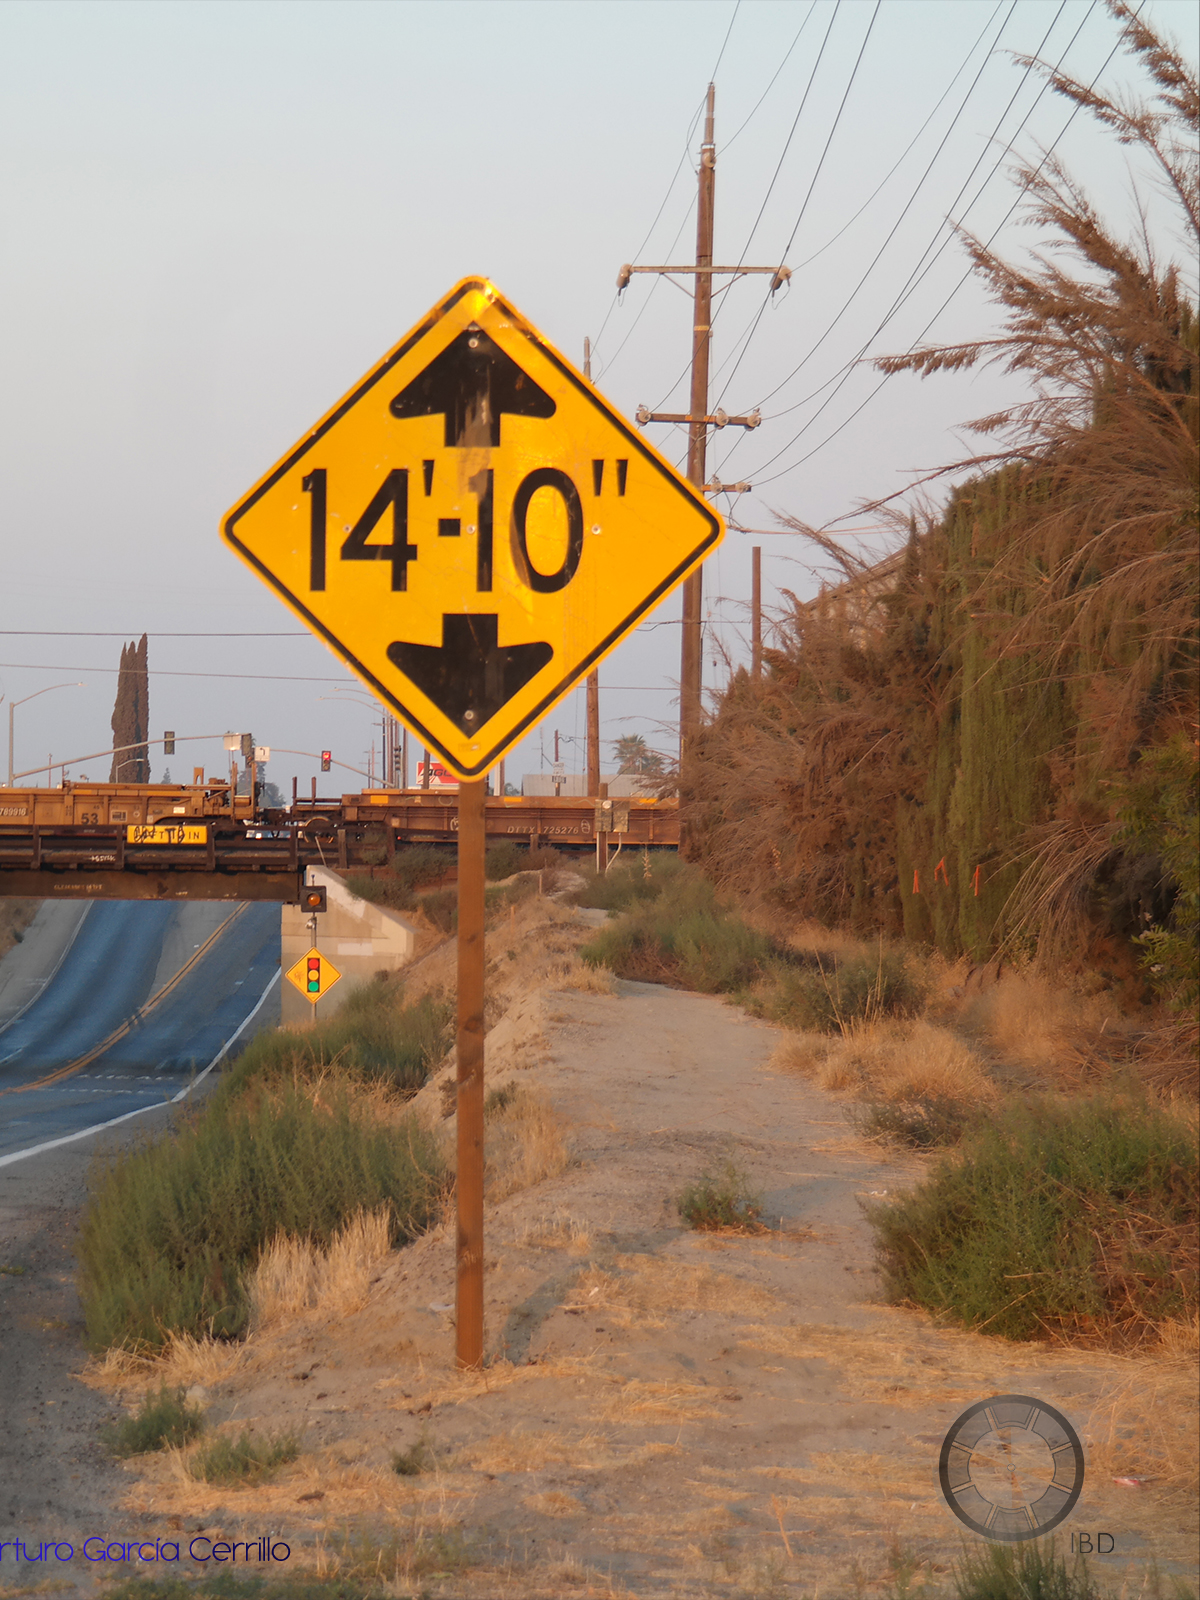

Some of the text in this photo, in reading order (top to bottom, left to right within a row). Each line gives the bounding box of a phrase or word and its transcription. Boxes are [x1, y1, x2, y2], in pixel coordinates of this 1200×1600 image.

[301, 459, 628, 594] 14'-10"
[81, 813, 99, 825] 53
[507, 826, 579, 834] DTTX 725276
